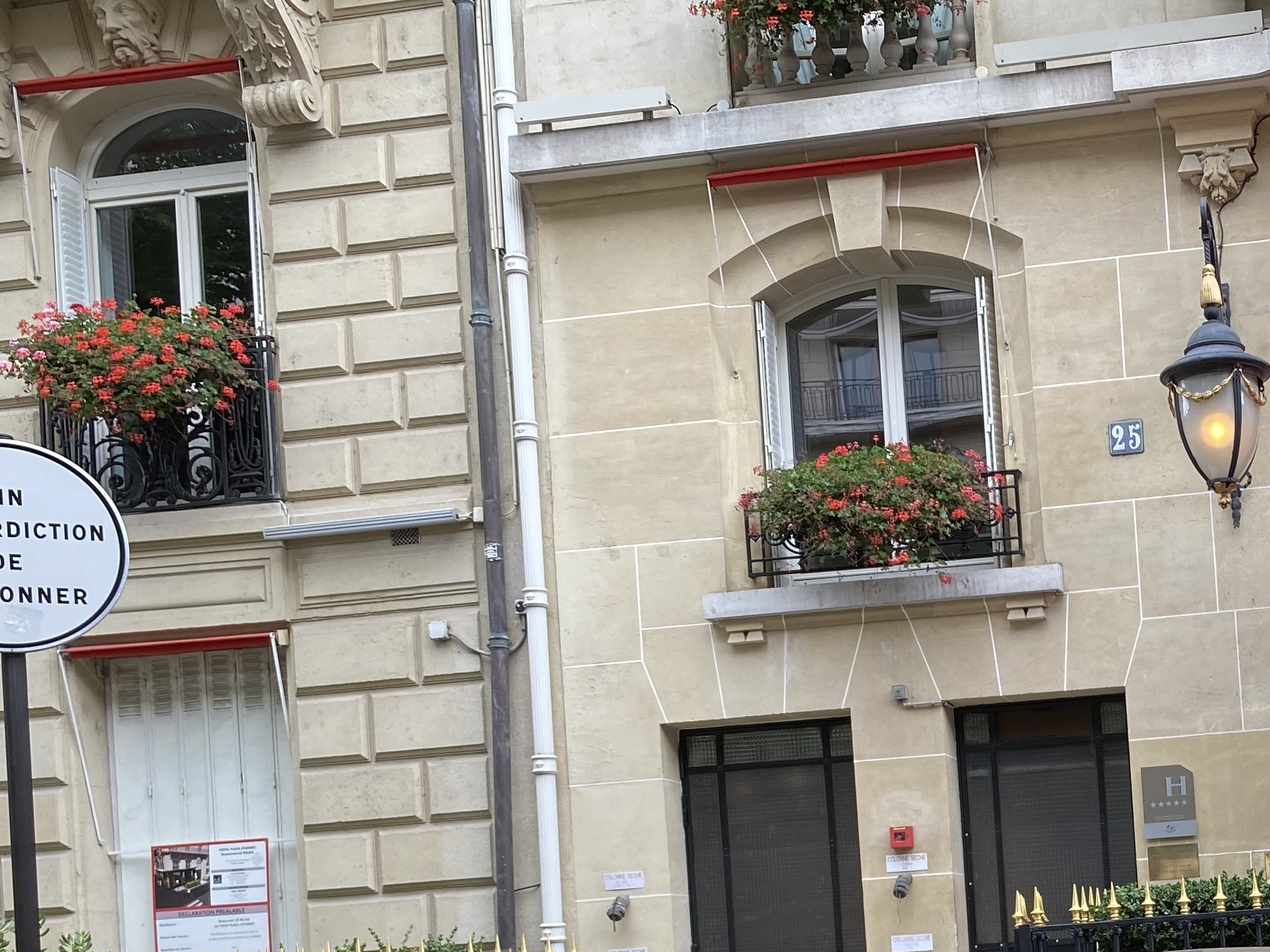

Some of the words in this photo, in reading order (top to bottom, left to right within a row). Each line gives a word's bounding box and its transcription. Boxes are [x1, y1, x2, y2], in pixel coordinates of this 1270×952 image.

[1111, 423, 1141, 451] 25
[0, 521, 105, 542] DICTION
[0, 586, 88, 605] ONNER
[1163, 775, 1188, 797] H
[177, 910, 215, 918] DECLARATION
[215, 907, 245, 915] PREALABLE
